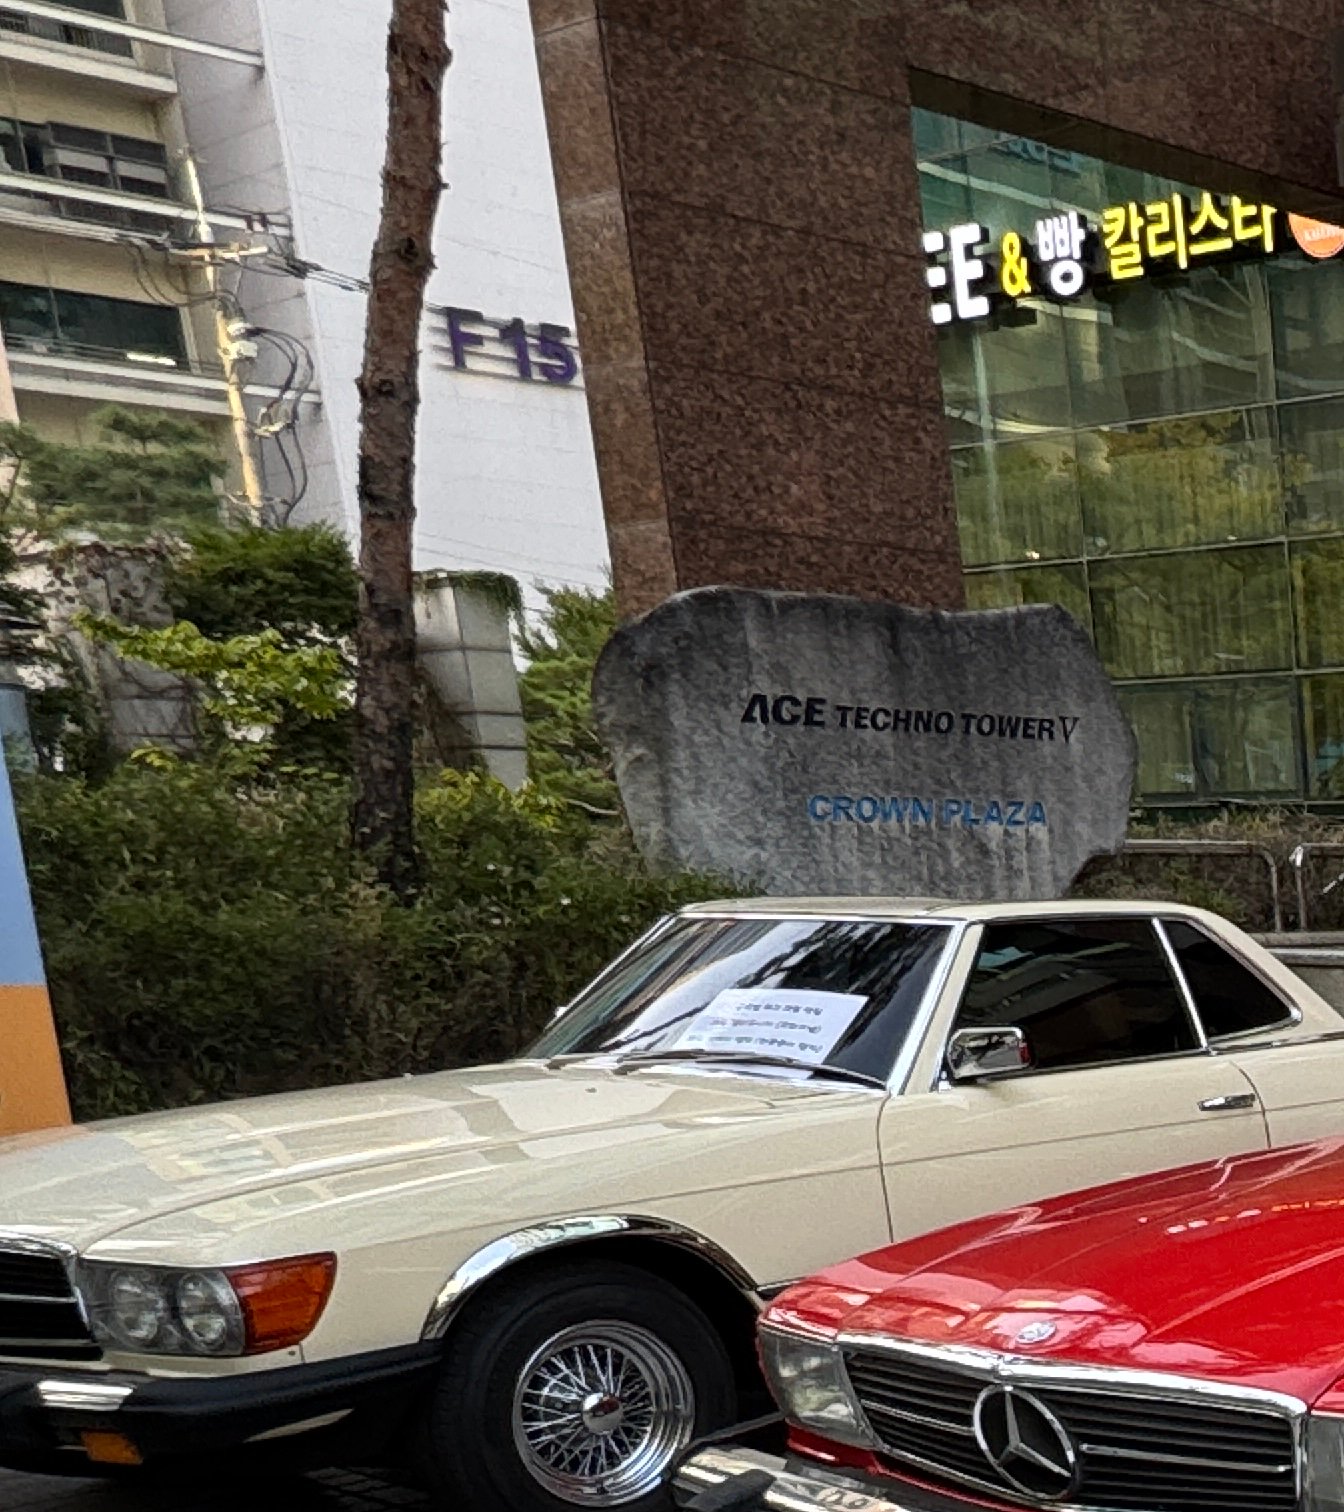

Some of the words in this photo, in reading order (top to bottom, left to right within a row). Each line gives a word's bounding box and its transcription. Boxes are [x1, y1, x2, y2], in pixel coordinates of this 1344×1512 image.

[1036, 211, 1085, 296] 빵
[1102, 191, 1278, 281] 칼리스타
[741, 693, 828, 727] ACE
[835, 704, 955, 735] TECHNO
[960, 713, 1056, 741] TOWER
[807, 794, 934, 825] CROWN
[942, 800, 1047, 827] PLAZA
